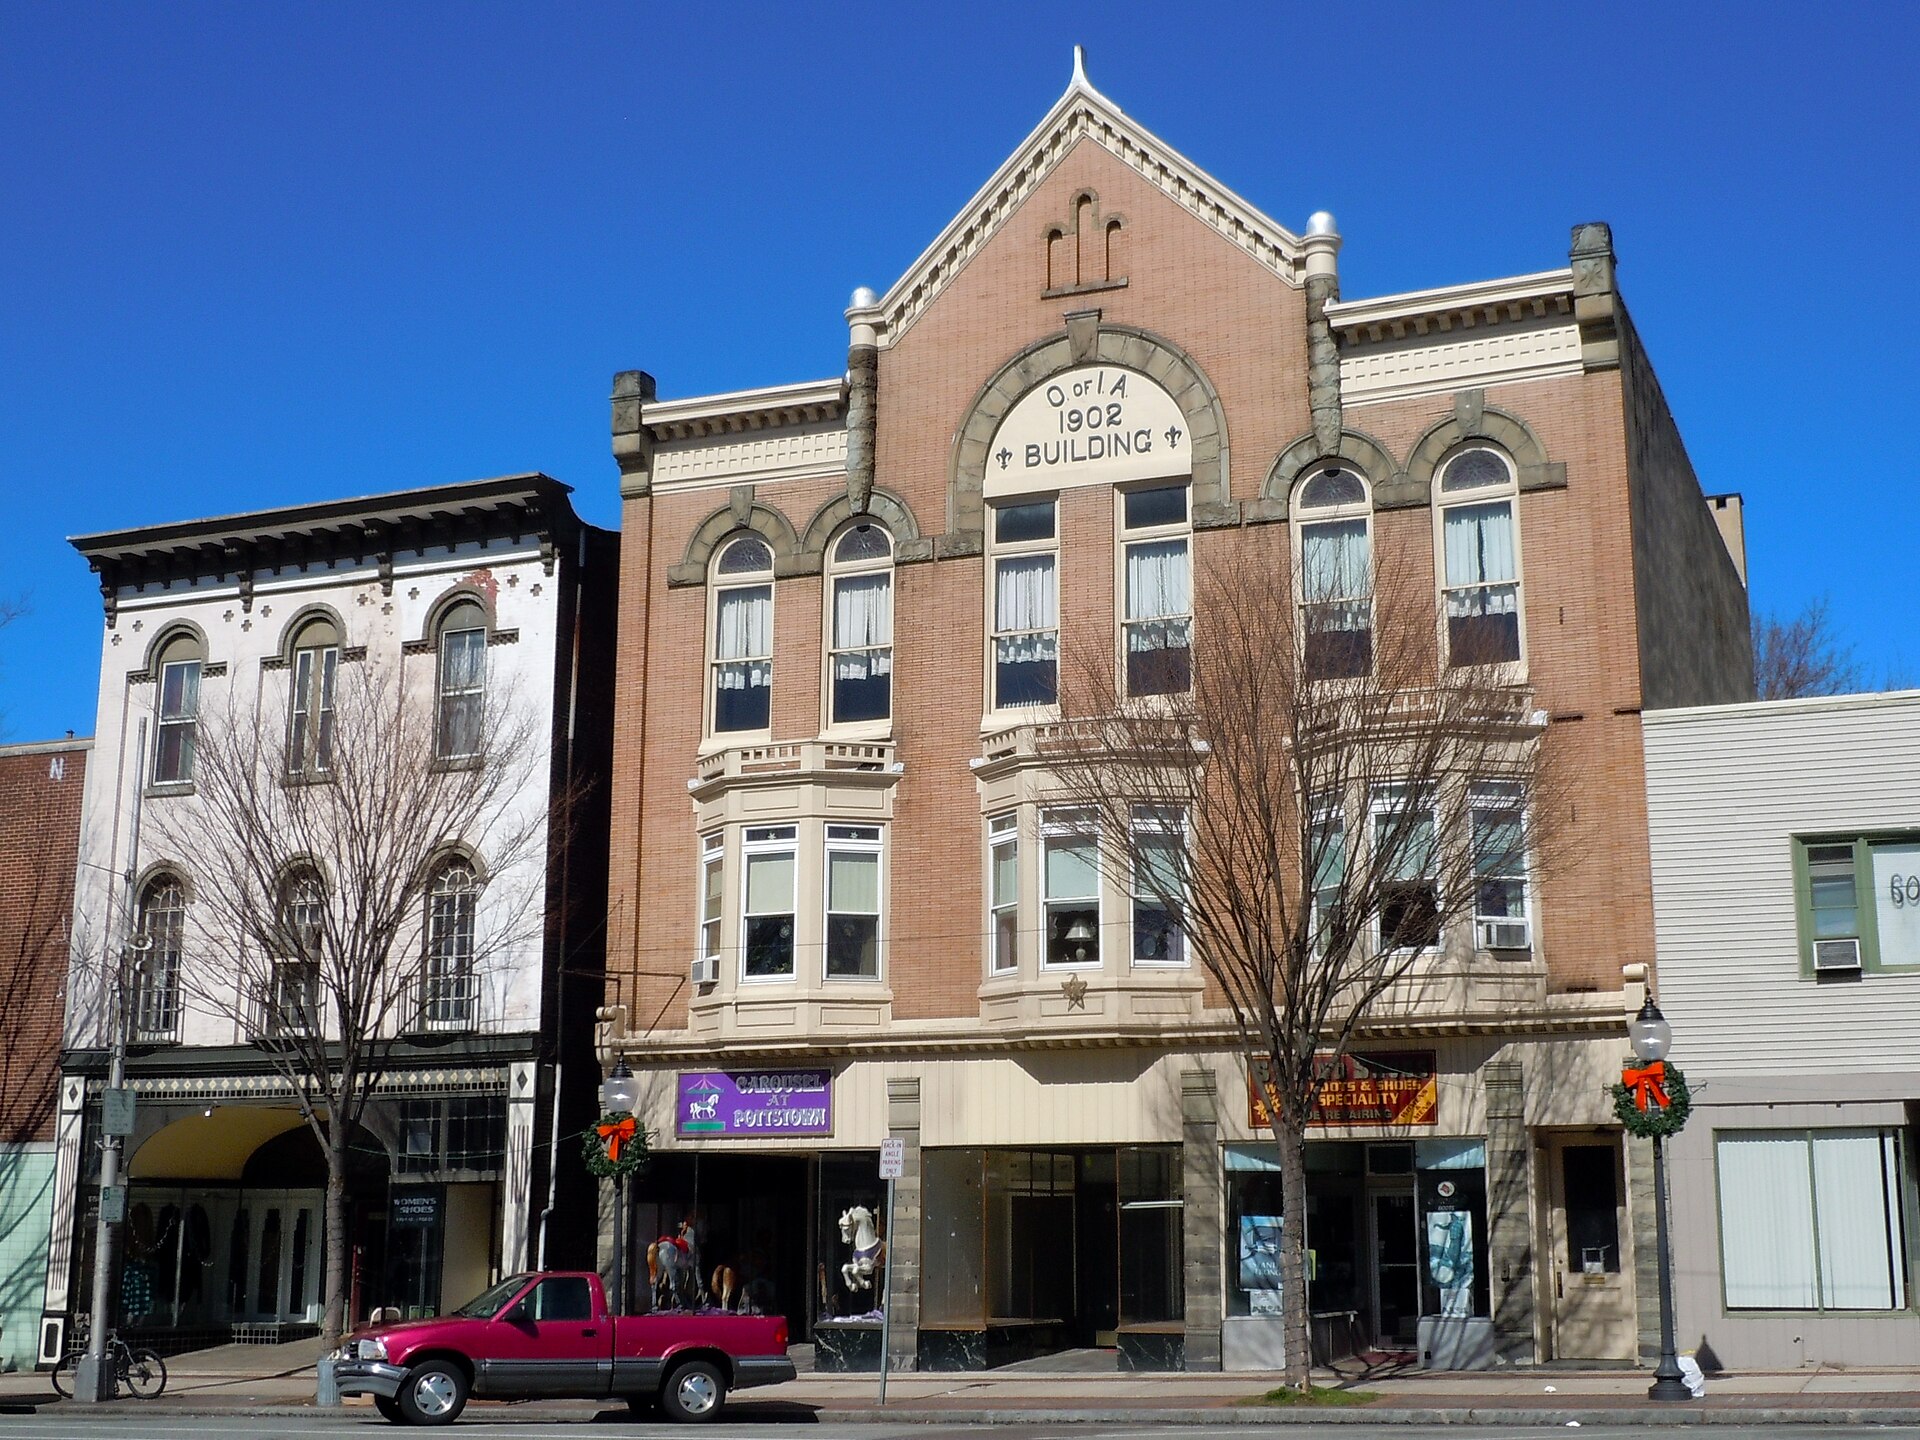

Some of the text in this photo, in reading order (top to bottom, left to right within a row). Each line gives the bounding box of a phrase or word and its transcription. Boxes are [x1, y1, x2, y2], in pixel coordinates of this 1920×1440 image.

[1073, 380, 1093, 397] OF
[1059, 403, 1122, 434] 1902
[1025, 428, 1152, 468] BUILDING
[735, 1074, 825, 1094] CAROUSEL
[1361, 1081, 1371, 1091] &
[1377, 1079, 1421, 1091] SHOES
[766, 1095, 790, 1106] AT
[1319, 1092, 1399, 1106] SPECIALITY
[733, 1107, 826, 1127] POTTSTOWN
[1326, 1109, 1392, 1120] REPAIRING
[399, 1206, 434, 1214] SHOES
